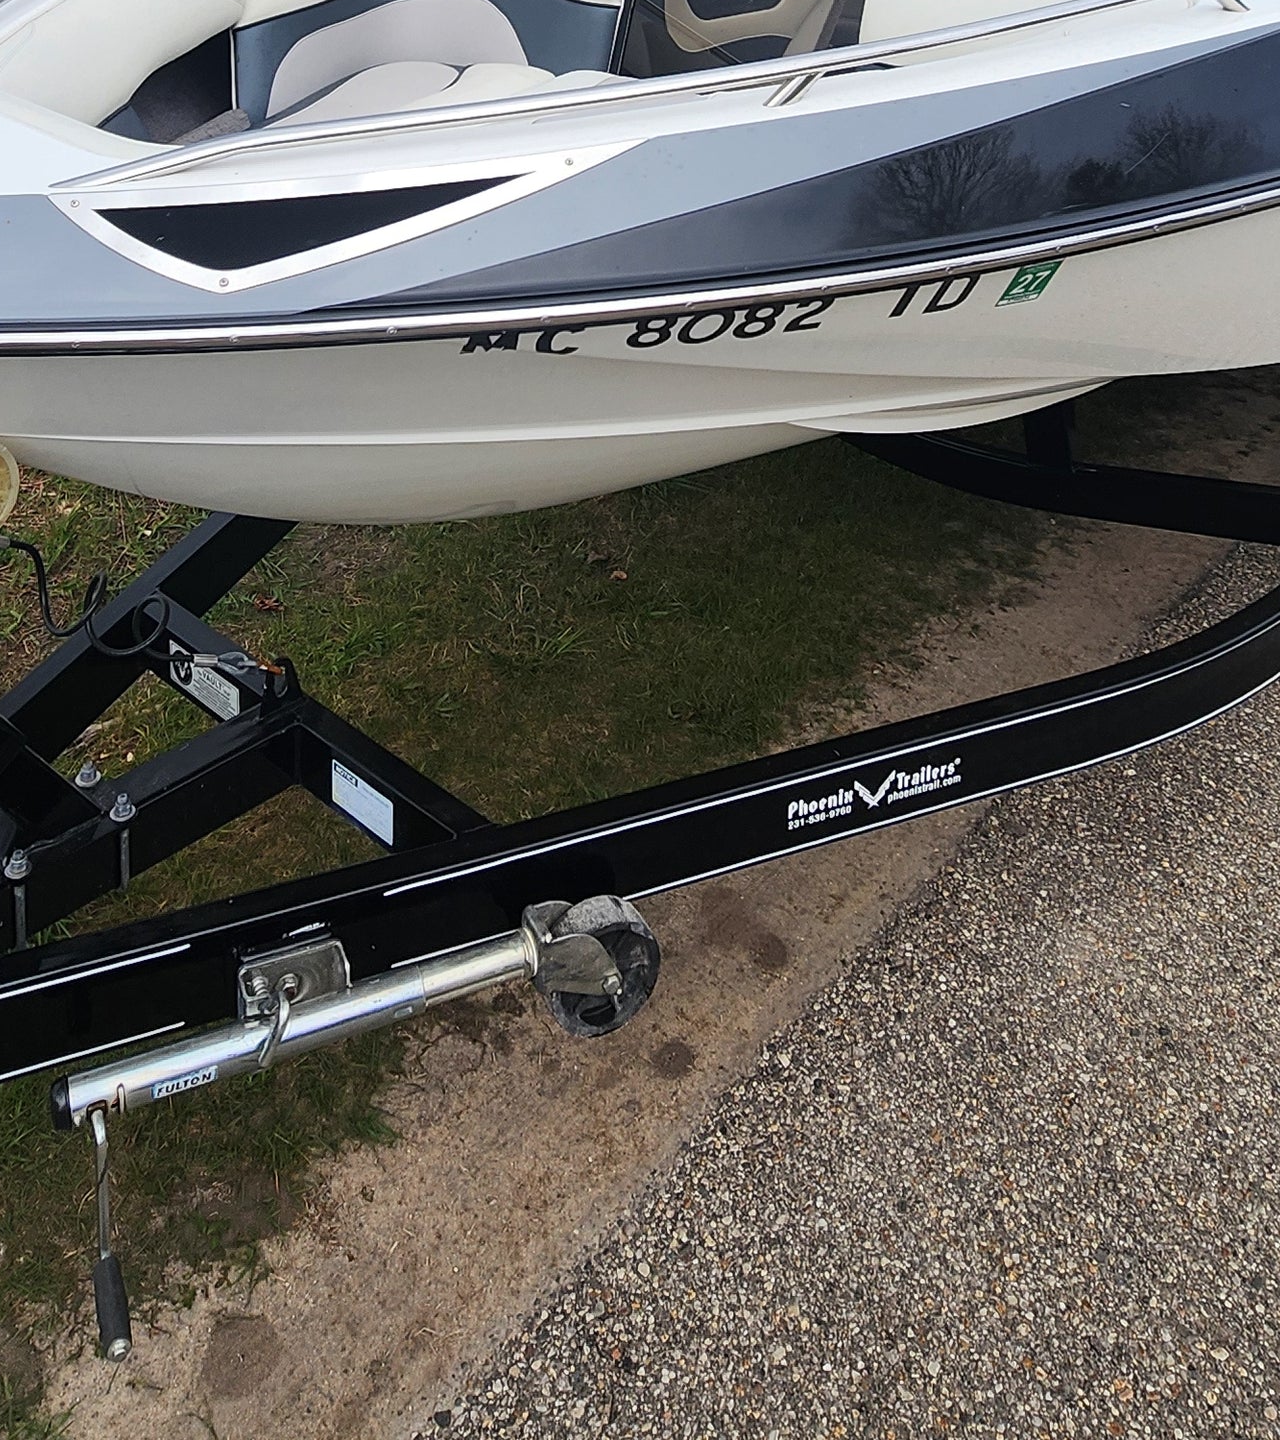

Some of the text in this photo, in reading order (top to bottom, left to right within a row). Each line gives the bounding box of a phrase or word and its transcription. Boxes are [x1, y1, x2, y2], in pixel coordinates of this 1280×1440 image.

[1009, 270, 1052, 295] 27
[626, 297, 836, 348] 8082
[787, 788, 854, 820] Phoenix
[887, 773, 962, 805] phoenixtrail.com
[157, 1071, 212, 1097] FULTON
